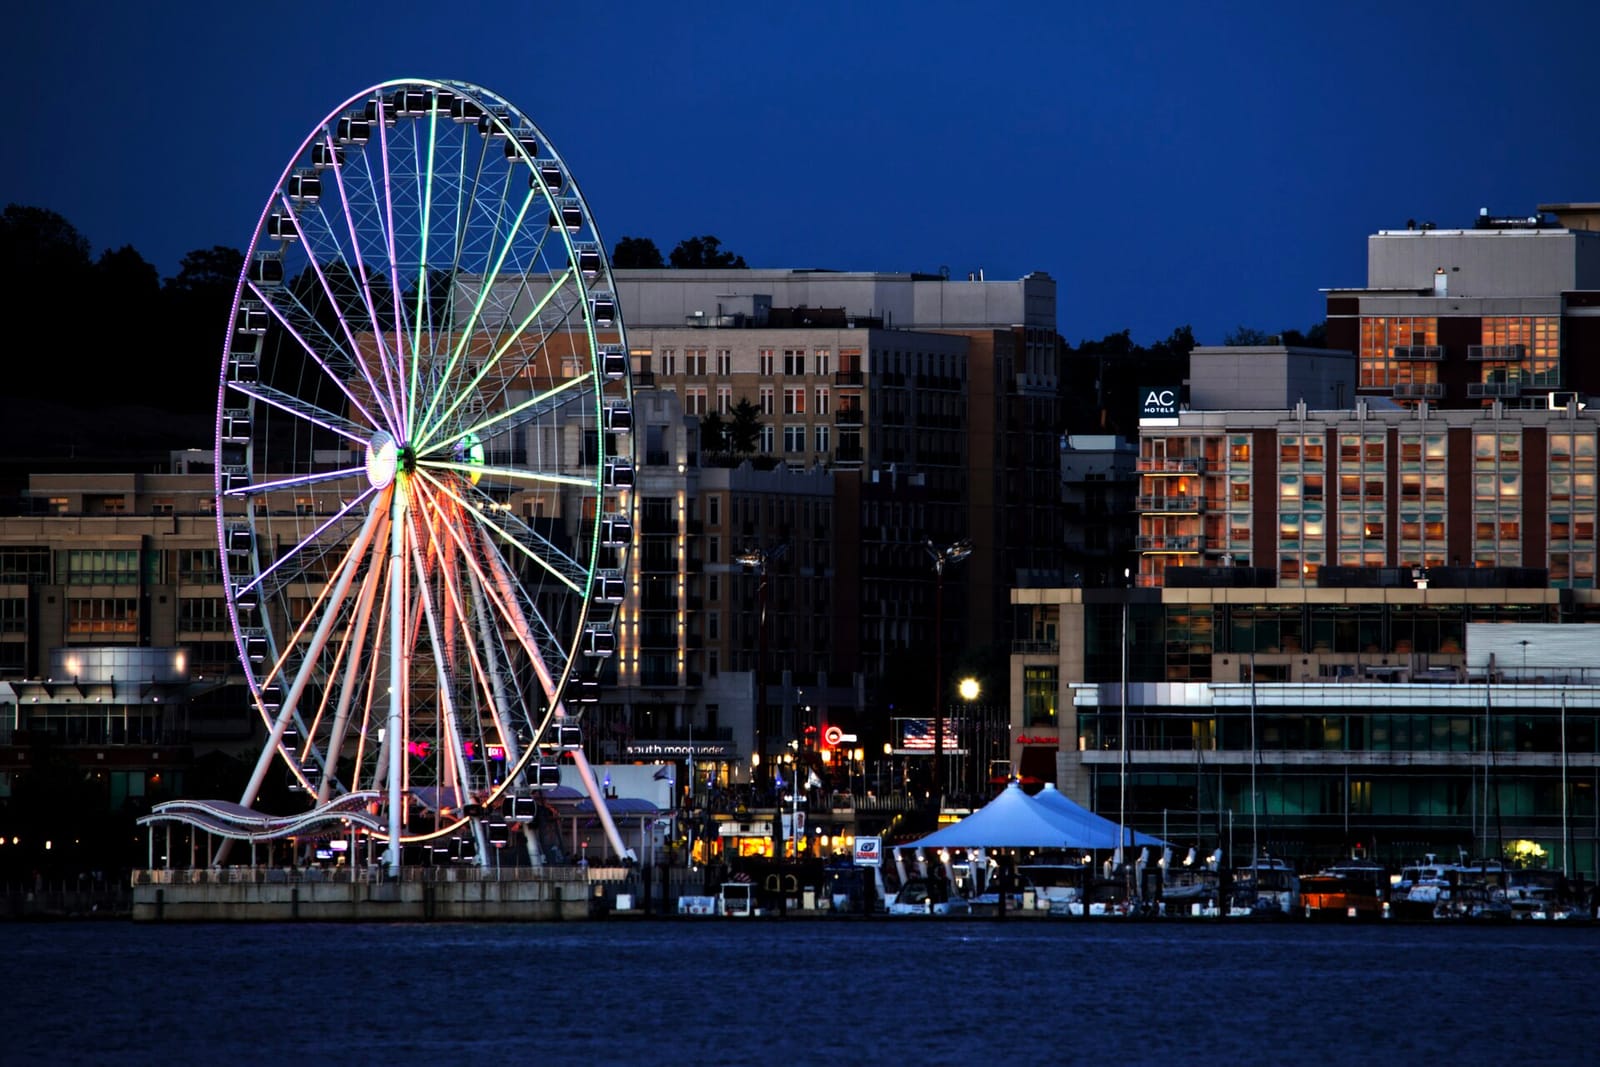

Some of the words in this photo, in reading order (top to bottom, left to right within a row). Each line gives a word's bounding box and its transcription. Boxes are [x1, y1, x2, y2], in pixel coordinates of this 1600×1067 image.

[1145, 391, 1174, 406] AC
[627, 745, 662, 754] south
[664, 746, 695, 754] moon
[697, 745, 724, 754] under
